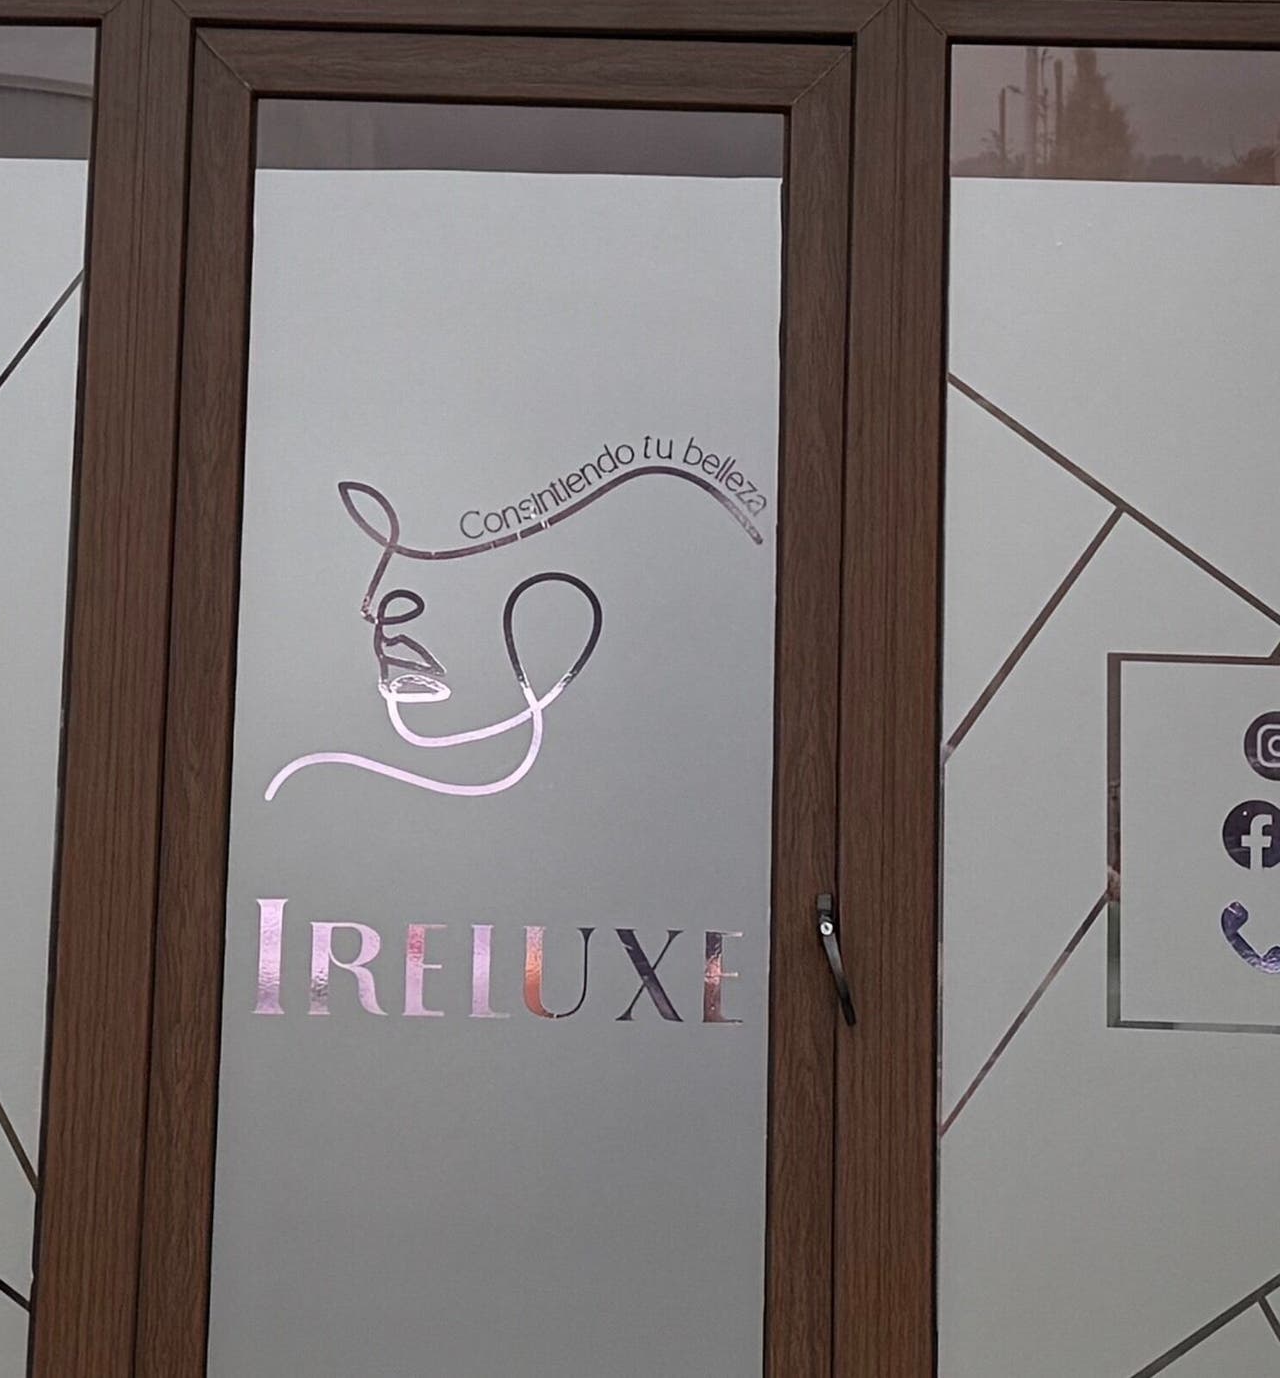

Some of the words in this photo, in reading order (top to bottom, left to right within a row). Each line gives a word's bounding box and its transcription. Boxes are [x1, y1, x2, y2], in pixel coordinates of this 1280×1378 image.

[643, 435, 674, 460] tu
[682, 437, 768, 518] belleza
[253, 898, 745, 1025] IRELUXE
